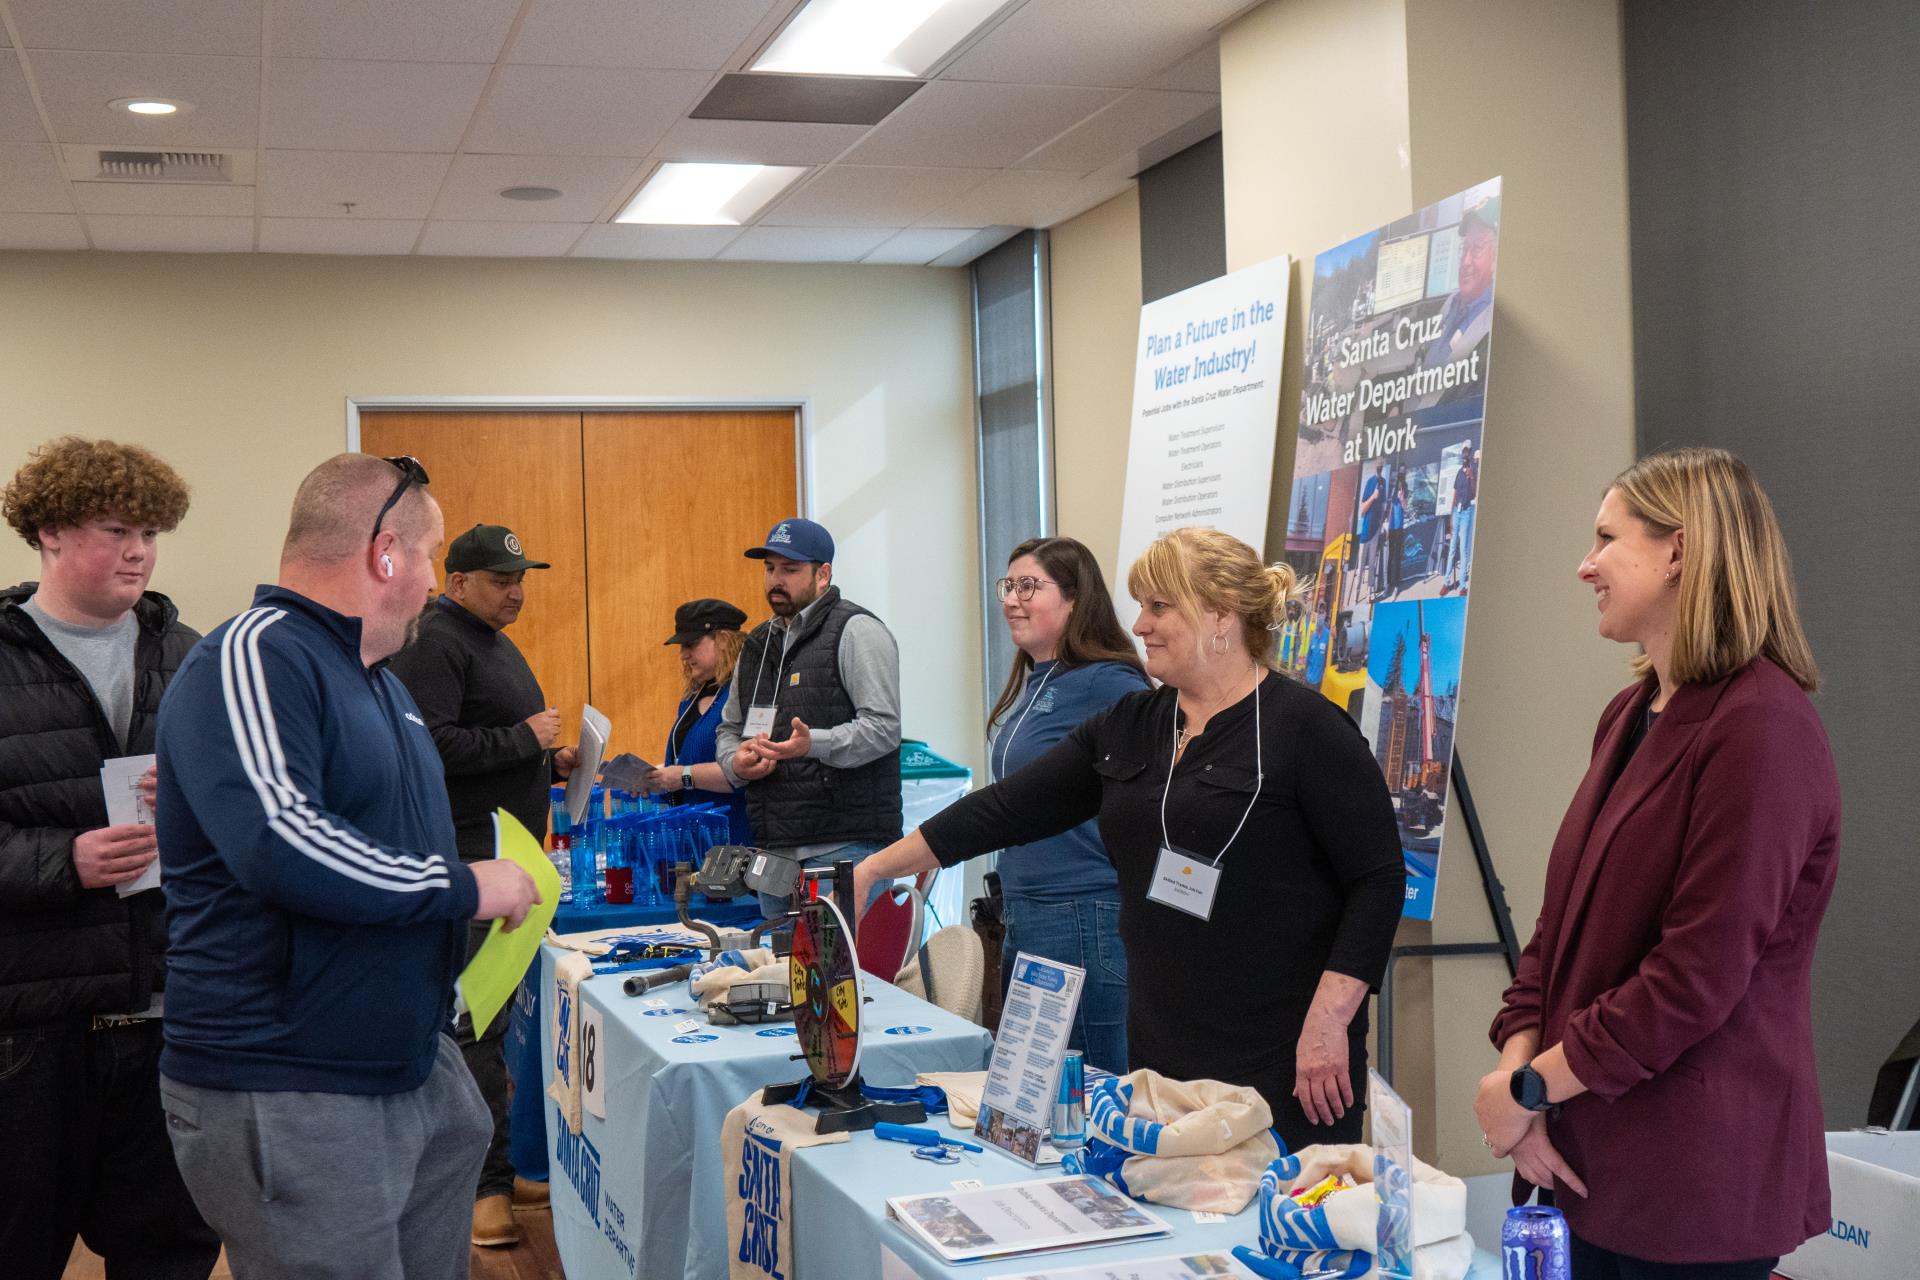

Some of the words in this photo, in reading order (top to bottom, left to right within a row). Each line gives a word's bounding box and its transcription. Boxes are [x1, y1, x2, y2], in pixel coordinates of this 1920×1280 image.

[1146, 334, 1172, 358] Plan
[1175, 332, 1182, 349] a
[1186, 316, 1228, 345] Future
[1232, 308, 1246, 332] in
[1250, 300, 1274, 325] the
[1340, 329, 1390, 368] Santa
[1395, 314, 1443, 350] Cruz
[1154, 365, 1191, 391] Water
[1193, 340, 1256, 380] Industry!
[1305, 390, 1356, 426] Water
[1359, 350, 1480, 414] Department
[1172, 401, 1182, 409] with
[1182, 398, 1190, 407] the
[1191, 395, 1205, 405] Santa
[1205, 392, 1217, 401] Cruz
[1217, 389, 1232, 399] Water
[1232, 380, 1264, 395] Department
[1343, 433, 1363, 463] at
[1367, 418, 1418, 458] Work
[582, 1019, 596, 1093] 18
[580, 1145, 601, 1231] CRUZ
[605, 1189, 625, 1231] WATER
